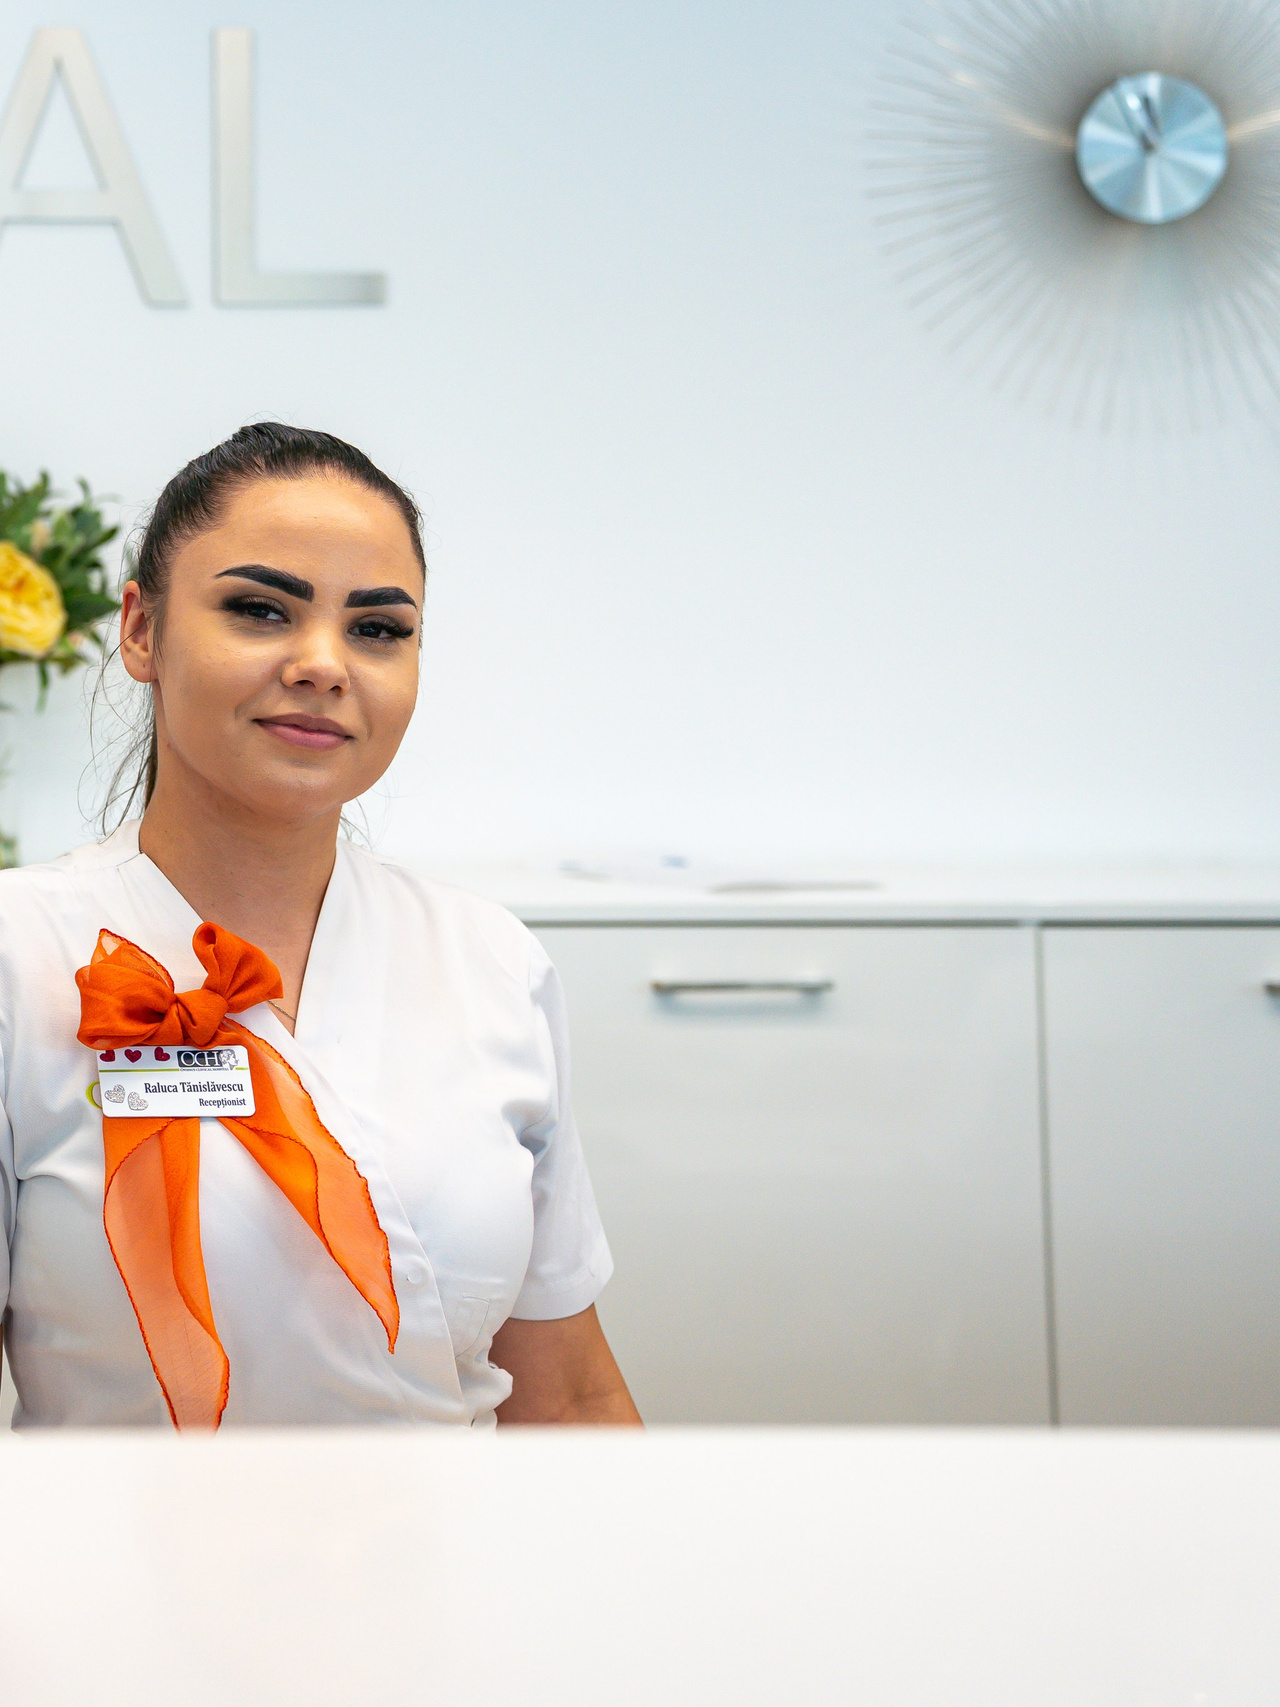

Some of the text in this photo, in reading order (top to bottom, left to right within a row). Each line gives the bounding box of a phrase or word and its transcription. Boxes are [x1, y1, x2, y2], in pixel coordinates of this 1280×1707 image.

[180, 1051, 220, 1067] OCH
[144, 1081, 244, 1094] Raluca Tănislăvescu
